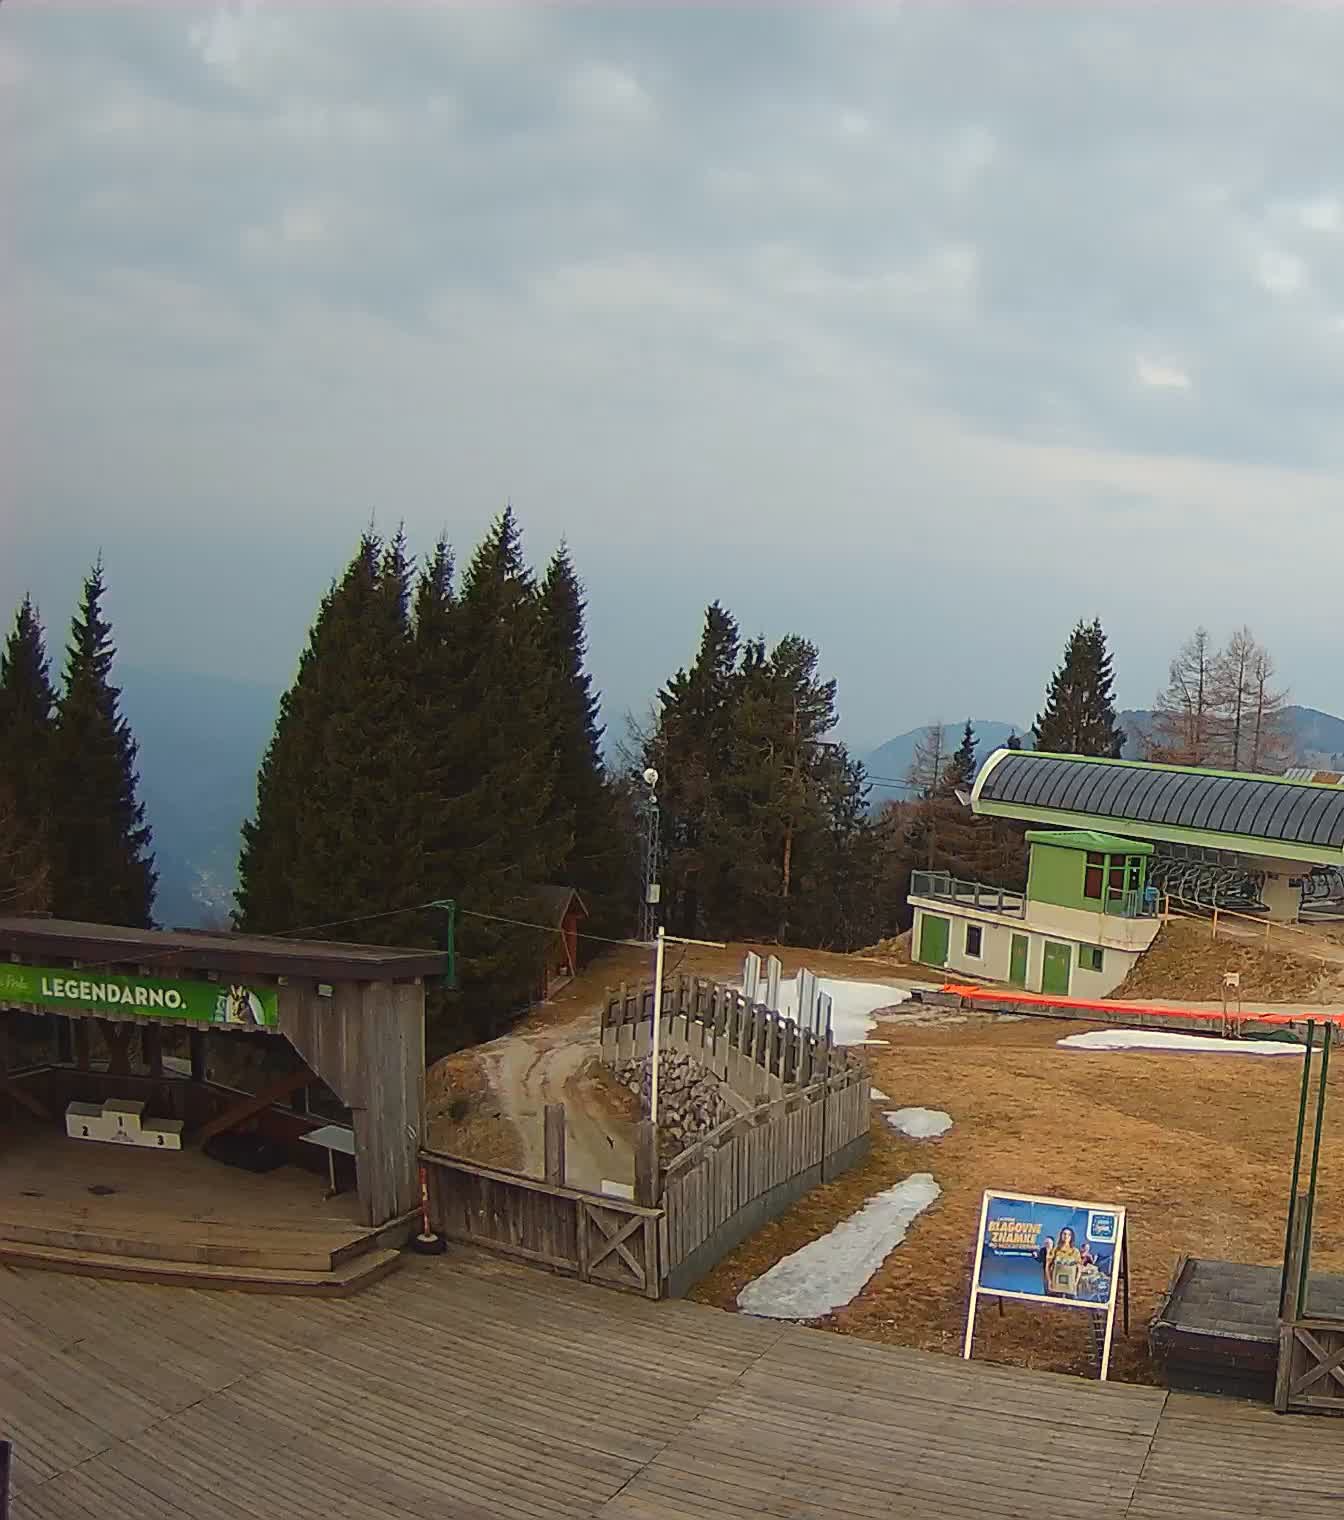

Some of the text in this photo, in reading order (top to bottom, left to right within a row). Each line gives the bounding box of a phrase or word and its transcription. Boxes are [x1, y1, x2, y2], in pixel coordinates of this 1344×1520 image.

[41, 977, 187, 1009] LEGENDARNO.
[82, 1126, 89, 1137] 2
[157, 1135, 164, 1146] 3
[988, 1221, 1043, 1234] BLAGOVNE
